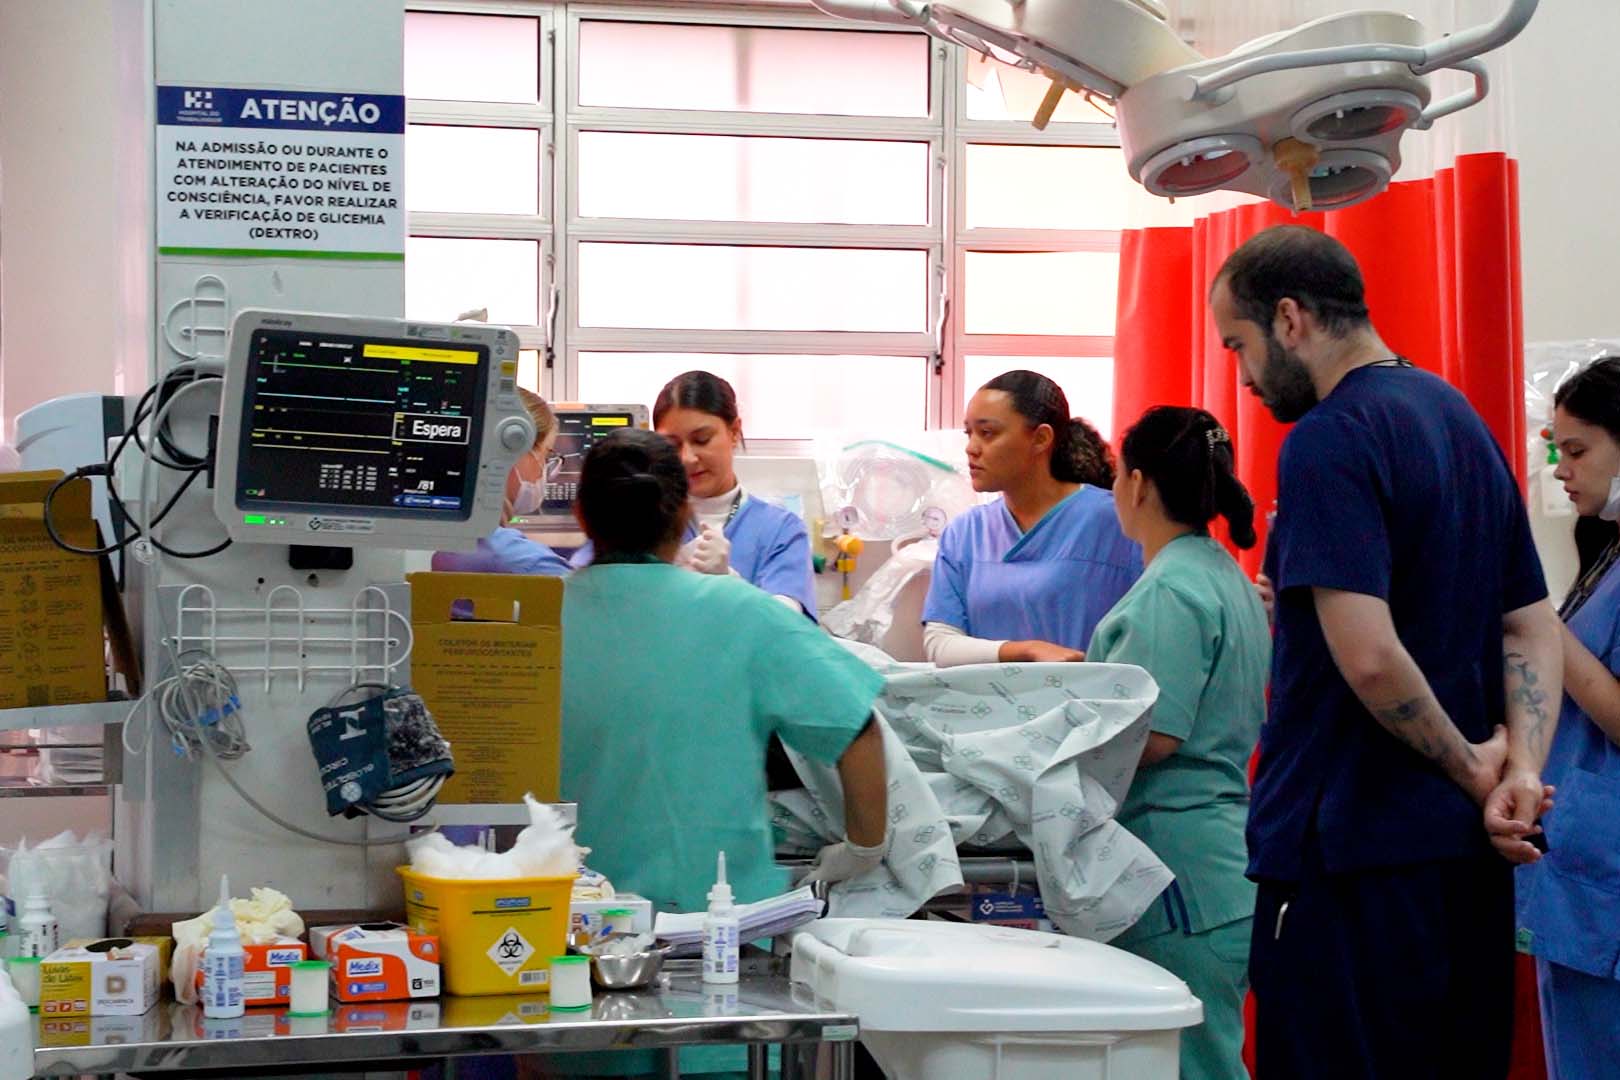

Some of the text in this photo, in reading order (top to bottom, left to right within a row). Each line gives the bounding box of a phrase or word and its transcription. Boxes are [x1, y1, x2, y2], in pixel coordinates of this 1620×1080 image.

[240, 97, 381, 126] ATENÇÃO
[175, 141, 388, 159] NA ADMISSÃO OU DURANTE O
[178, 159, 387, 175] ATENDIMENTO DE PACIENTES
[174, 175, 390, 192] COM ALTERAÇÃO DO NÍVEL DE
[167, 191, 397, 208] CONSCIÊNCIA, FAVOR REALIZAR
[179, 208, 385, 224] A VERIFICAÇÃO DE GLICEMIA
[249, 228, 318, 240] (DEXTRO)
[412, 419, 462, 439] Espera
[350, 960, 379, 971] Medix
